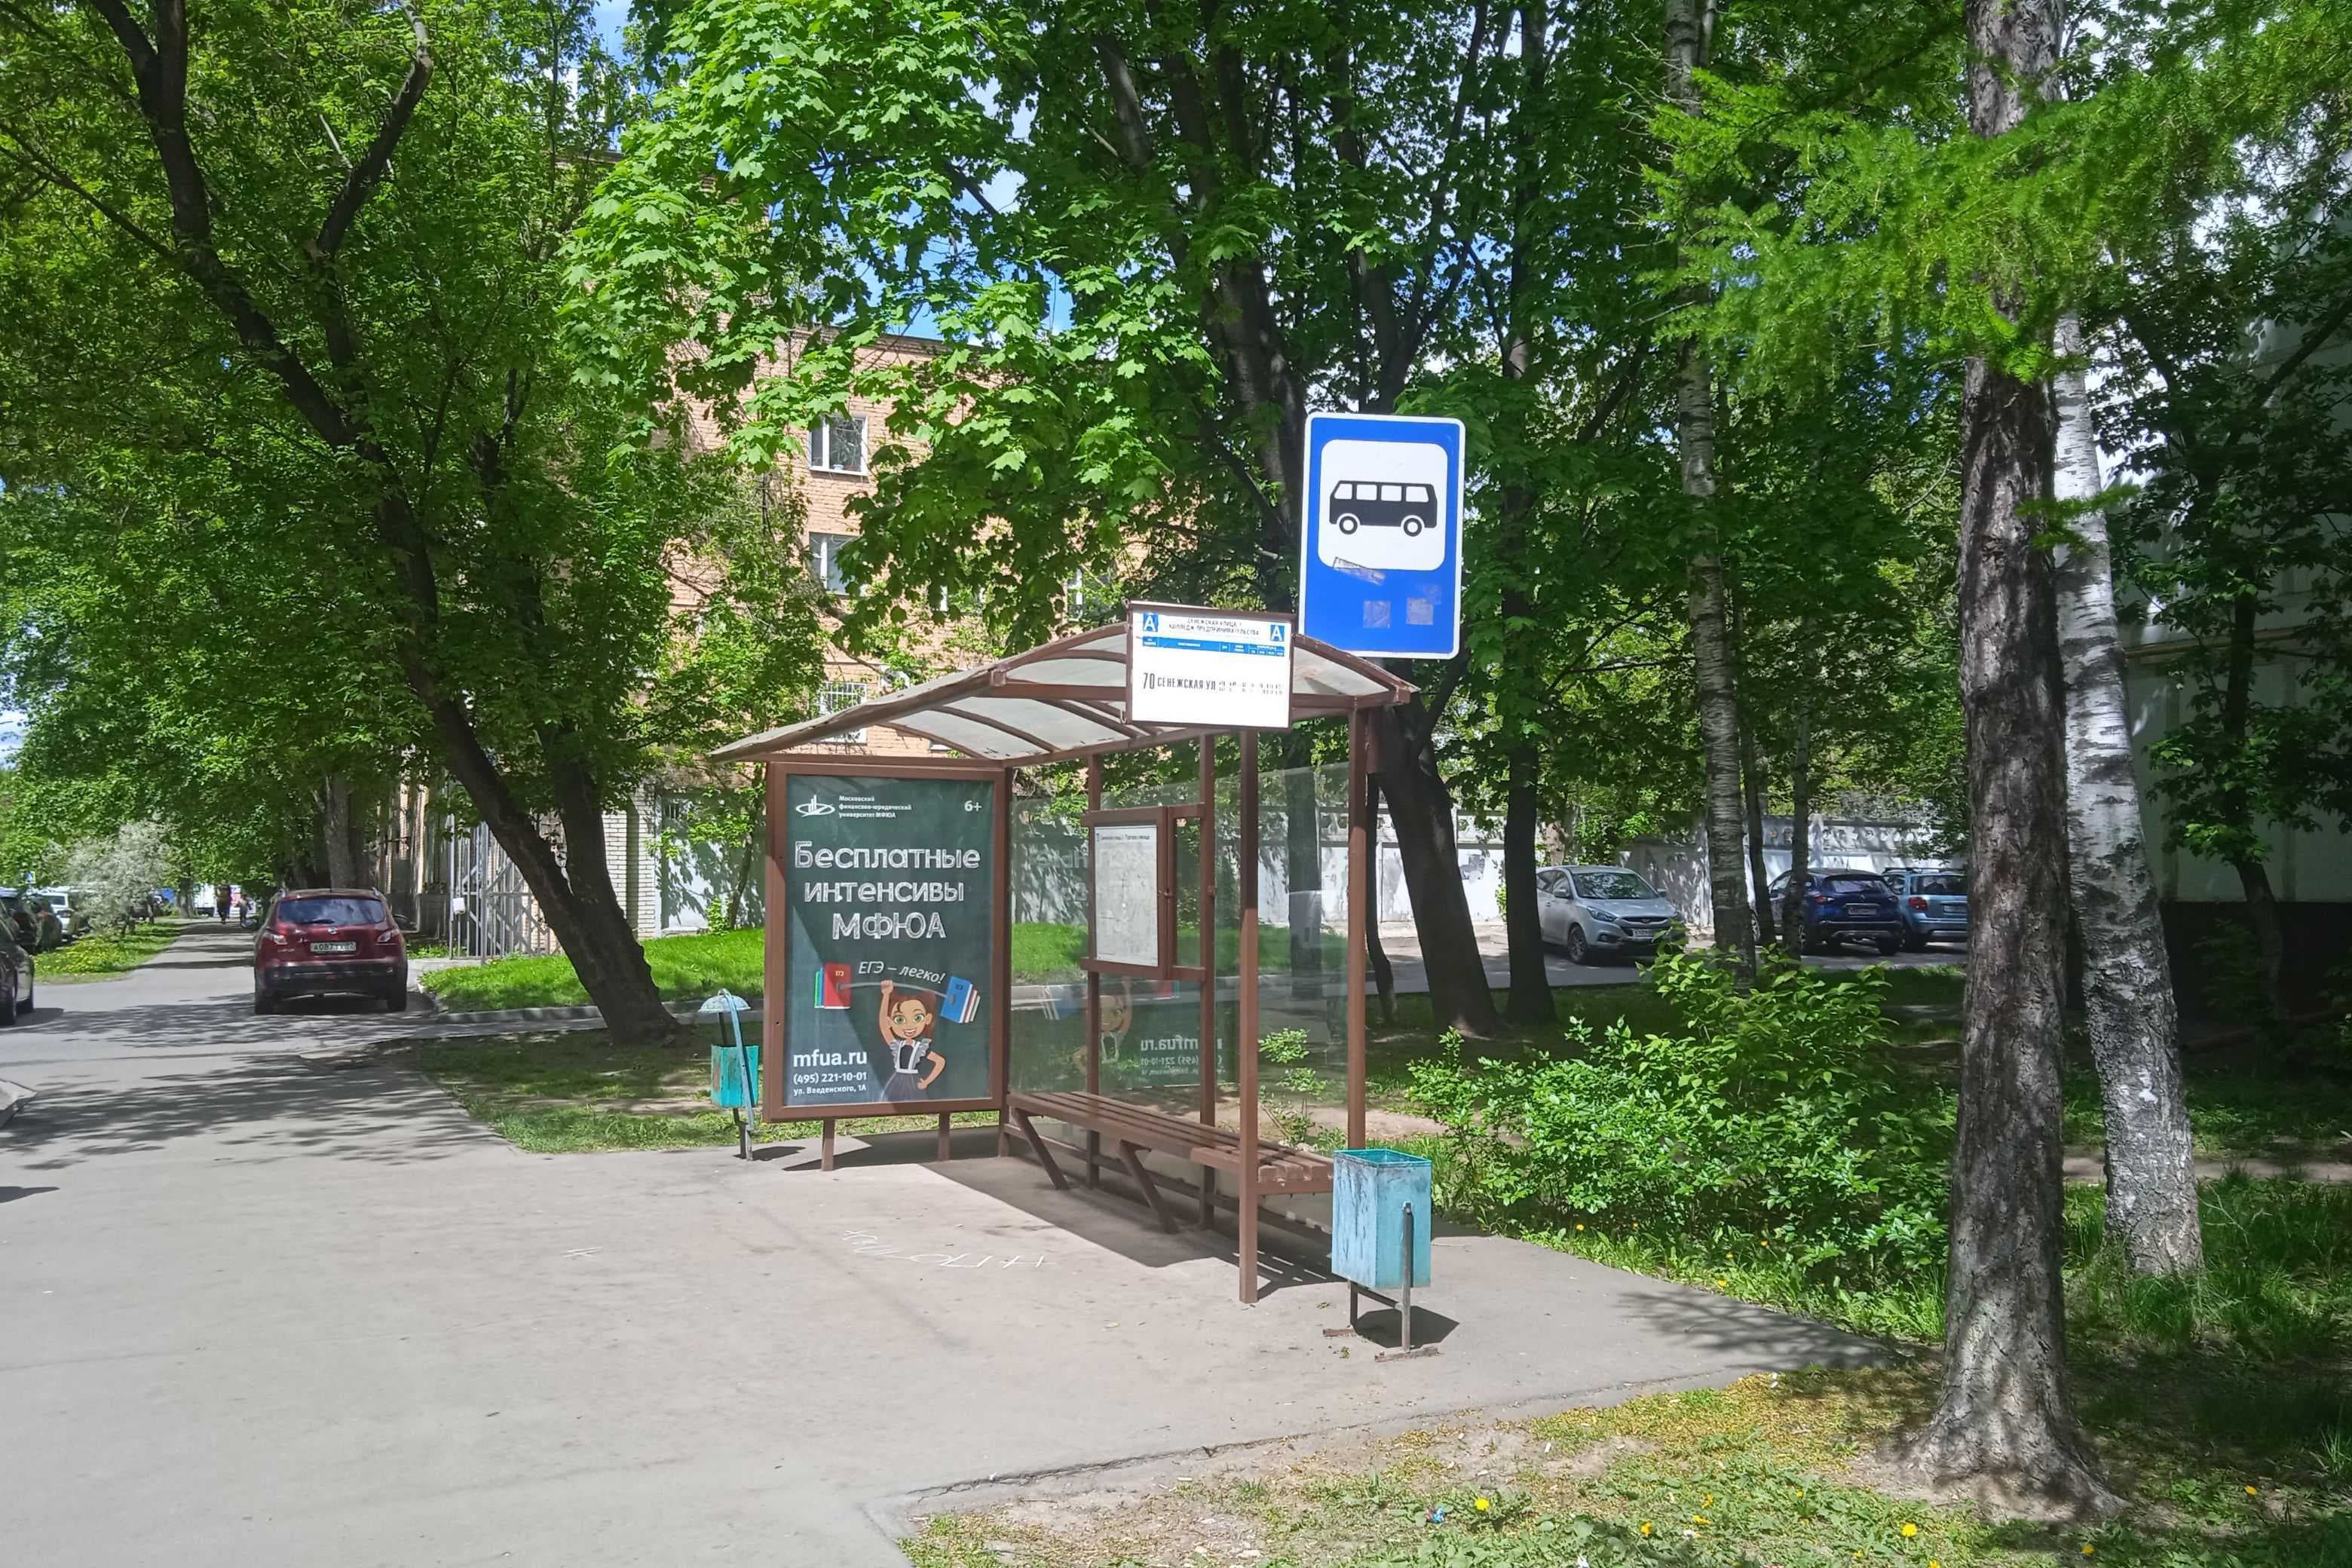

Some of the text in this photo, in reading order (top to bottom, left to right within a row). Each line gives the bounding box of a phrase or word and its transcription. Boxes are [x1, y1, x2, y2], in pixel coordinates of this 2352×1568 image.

[1143, 614, 1157, 632] А
[1271, 625, 1283, 642] А
[1143, 672, 1155, 690] 70
[1157, 676, 1204, 690] СЕНЕЖСКАЯ
[1206, 680, 1216, 691] УЛ
[964, 801, 982, 812] 6+
[795, 841, 981, 868] Бесплатные
[831, 911, 947, 940] МФЮА
[858, 961, 884, 975] ЕГЭ
[899, 966, 946, 984] легко!
[793, 1049, 867, 1067] mfua.ru
[793, 1071, 867, 1085] (495) 221-10-01
[793, 1083, 867, 1096] ул. Введенского, 1А
